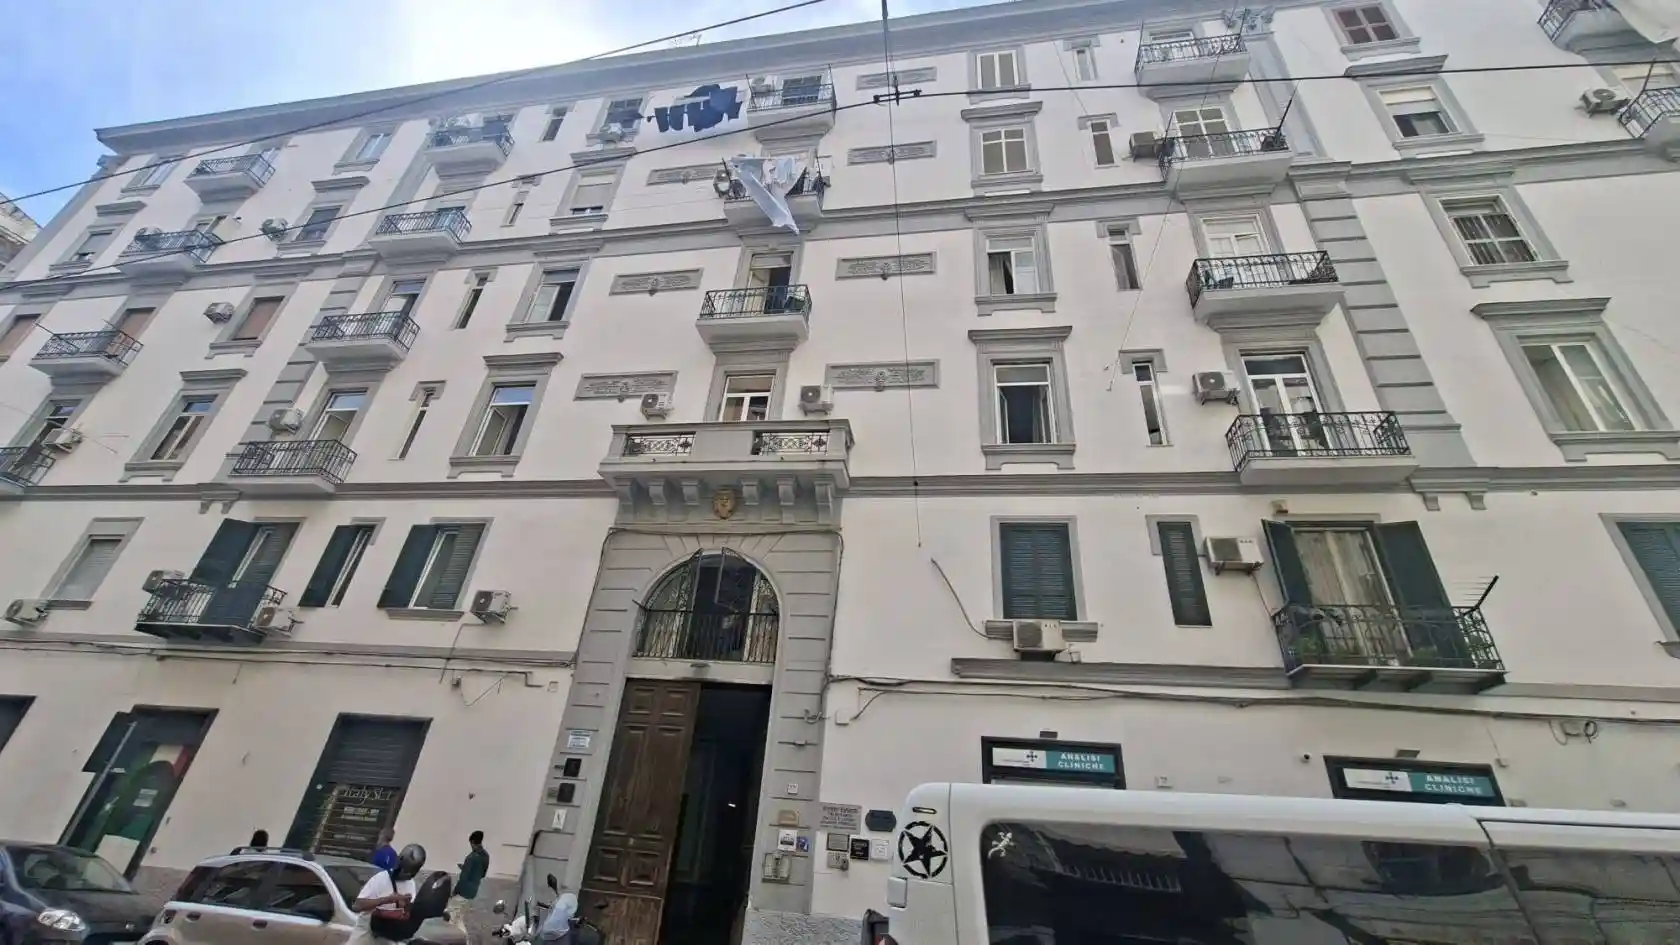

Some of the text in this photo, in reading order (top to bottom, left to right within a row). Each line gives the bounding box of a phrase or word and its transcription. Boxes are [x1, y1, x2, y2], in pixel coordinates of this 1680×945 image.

[1060, 751, 1101, 762] ANALISI
[1057, 761, 1105, 770] CLINICHE
[1426, 774, 1476, 785] ANALISI
[1424, 783, 1484, 795] CLINICHE
